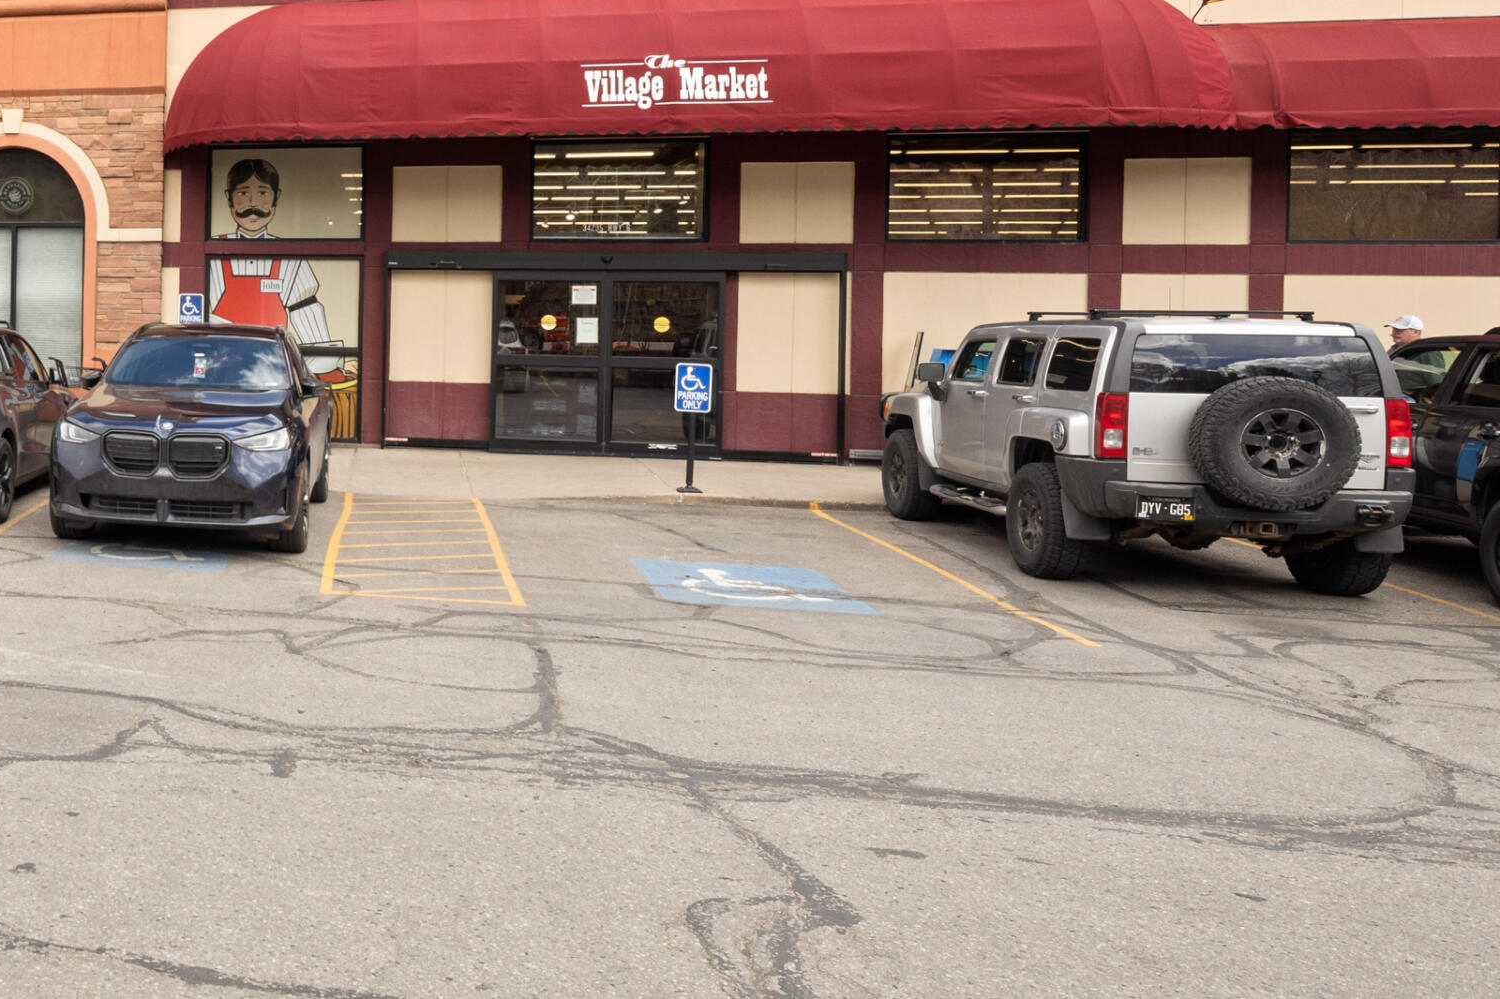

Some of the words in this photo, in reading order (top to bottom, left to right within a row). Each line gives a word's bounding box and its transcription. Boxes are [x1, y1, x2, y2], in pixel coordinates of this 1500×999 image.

[644, 54, 687, 69] The
[584, 69, 664, 109] Village
[679, 66, 769, 100] Market
[262, 281, 280, 291] John
[678, 391, 708, 401] PARKING
[683, 400, 703, 409] ONLY
